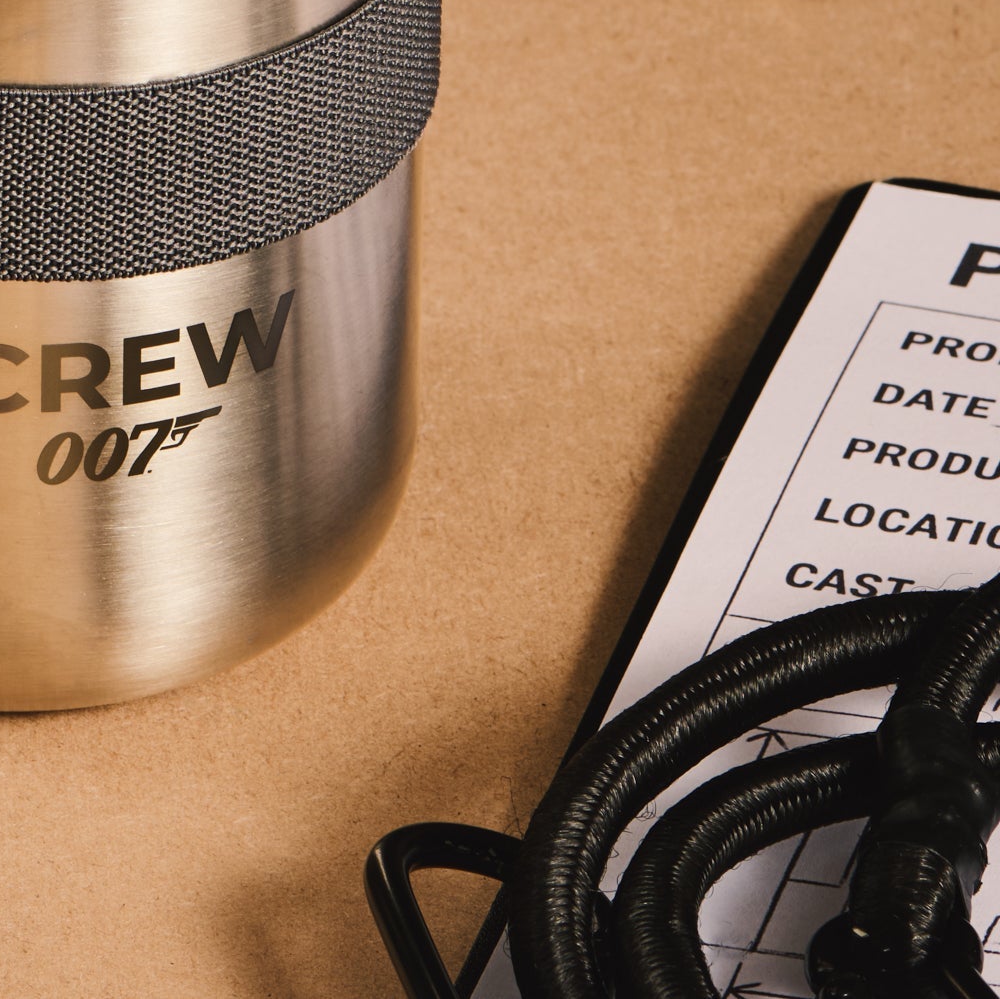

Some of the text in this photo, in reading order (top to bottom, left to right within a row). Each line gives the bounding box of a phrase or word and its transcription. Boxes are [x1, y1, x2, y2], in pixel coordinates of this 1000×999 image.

[901, 331, 1000, 365] PRO
[873, 382, 996, 419] DATE
[36, 416, 178, 486] 007
[843, 437, 1000, 480] PRODU
[785, 562, 915, 599] CAST
